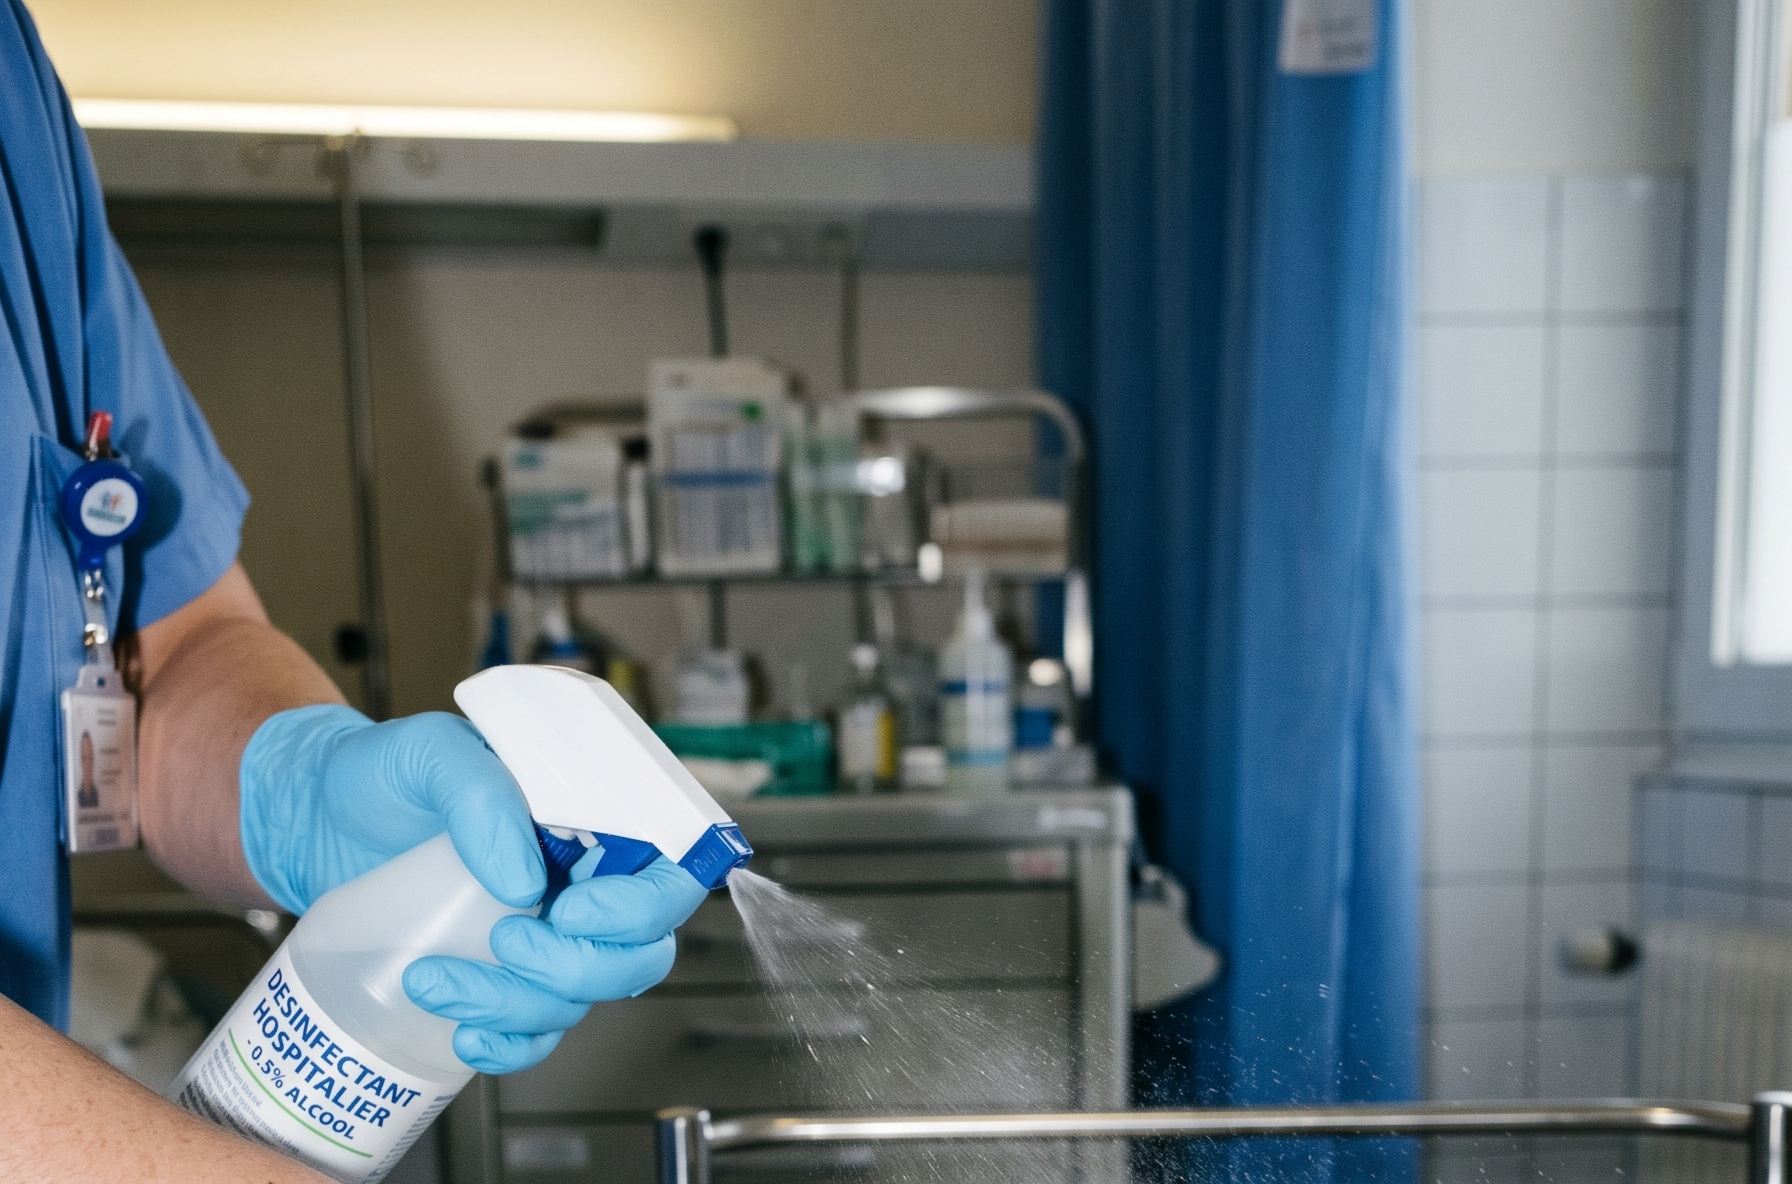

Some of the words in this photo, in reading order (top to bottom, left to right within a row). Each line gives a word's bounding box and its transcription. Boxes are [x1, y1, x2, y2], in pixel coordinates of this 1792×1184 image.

[251, 1045, 286, 1089] 0.5%
[285, 1086, 356, 1140] ALCOOL
[253, 997, 391, 1127] HOSPITALIER
[267, 968, 421, 1108] DESINFECTANT
